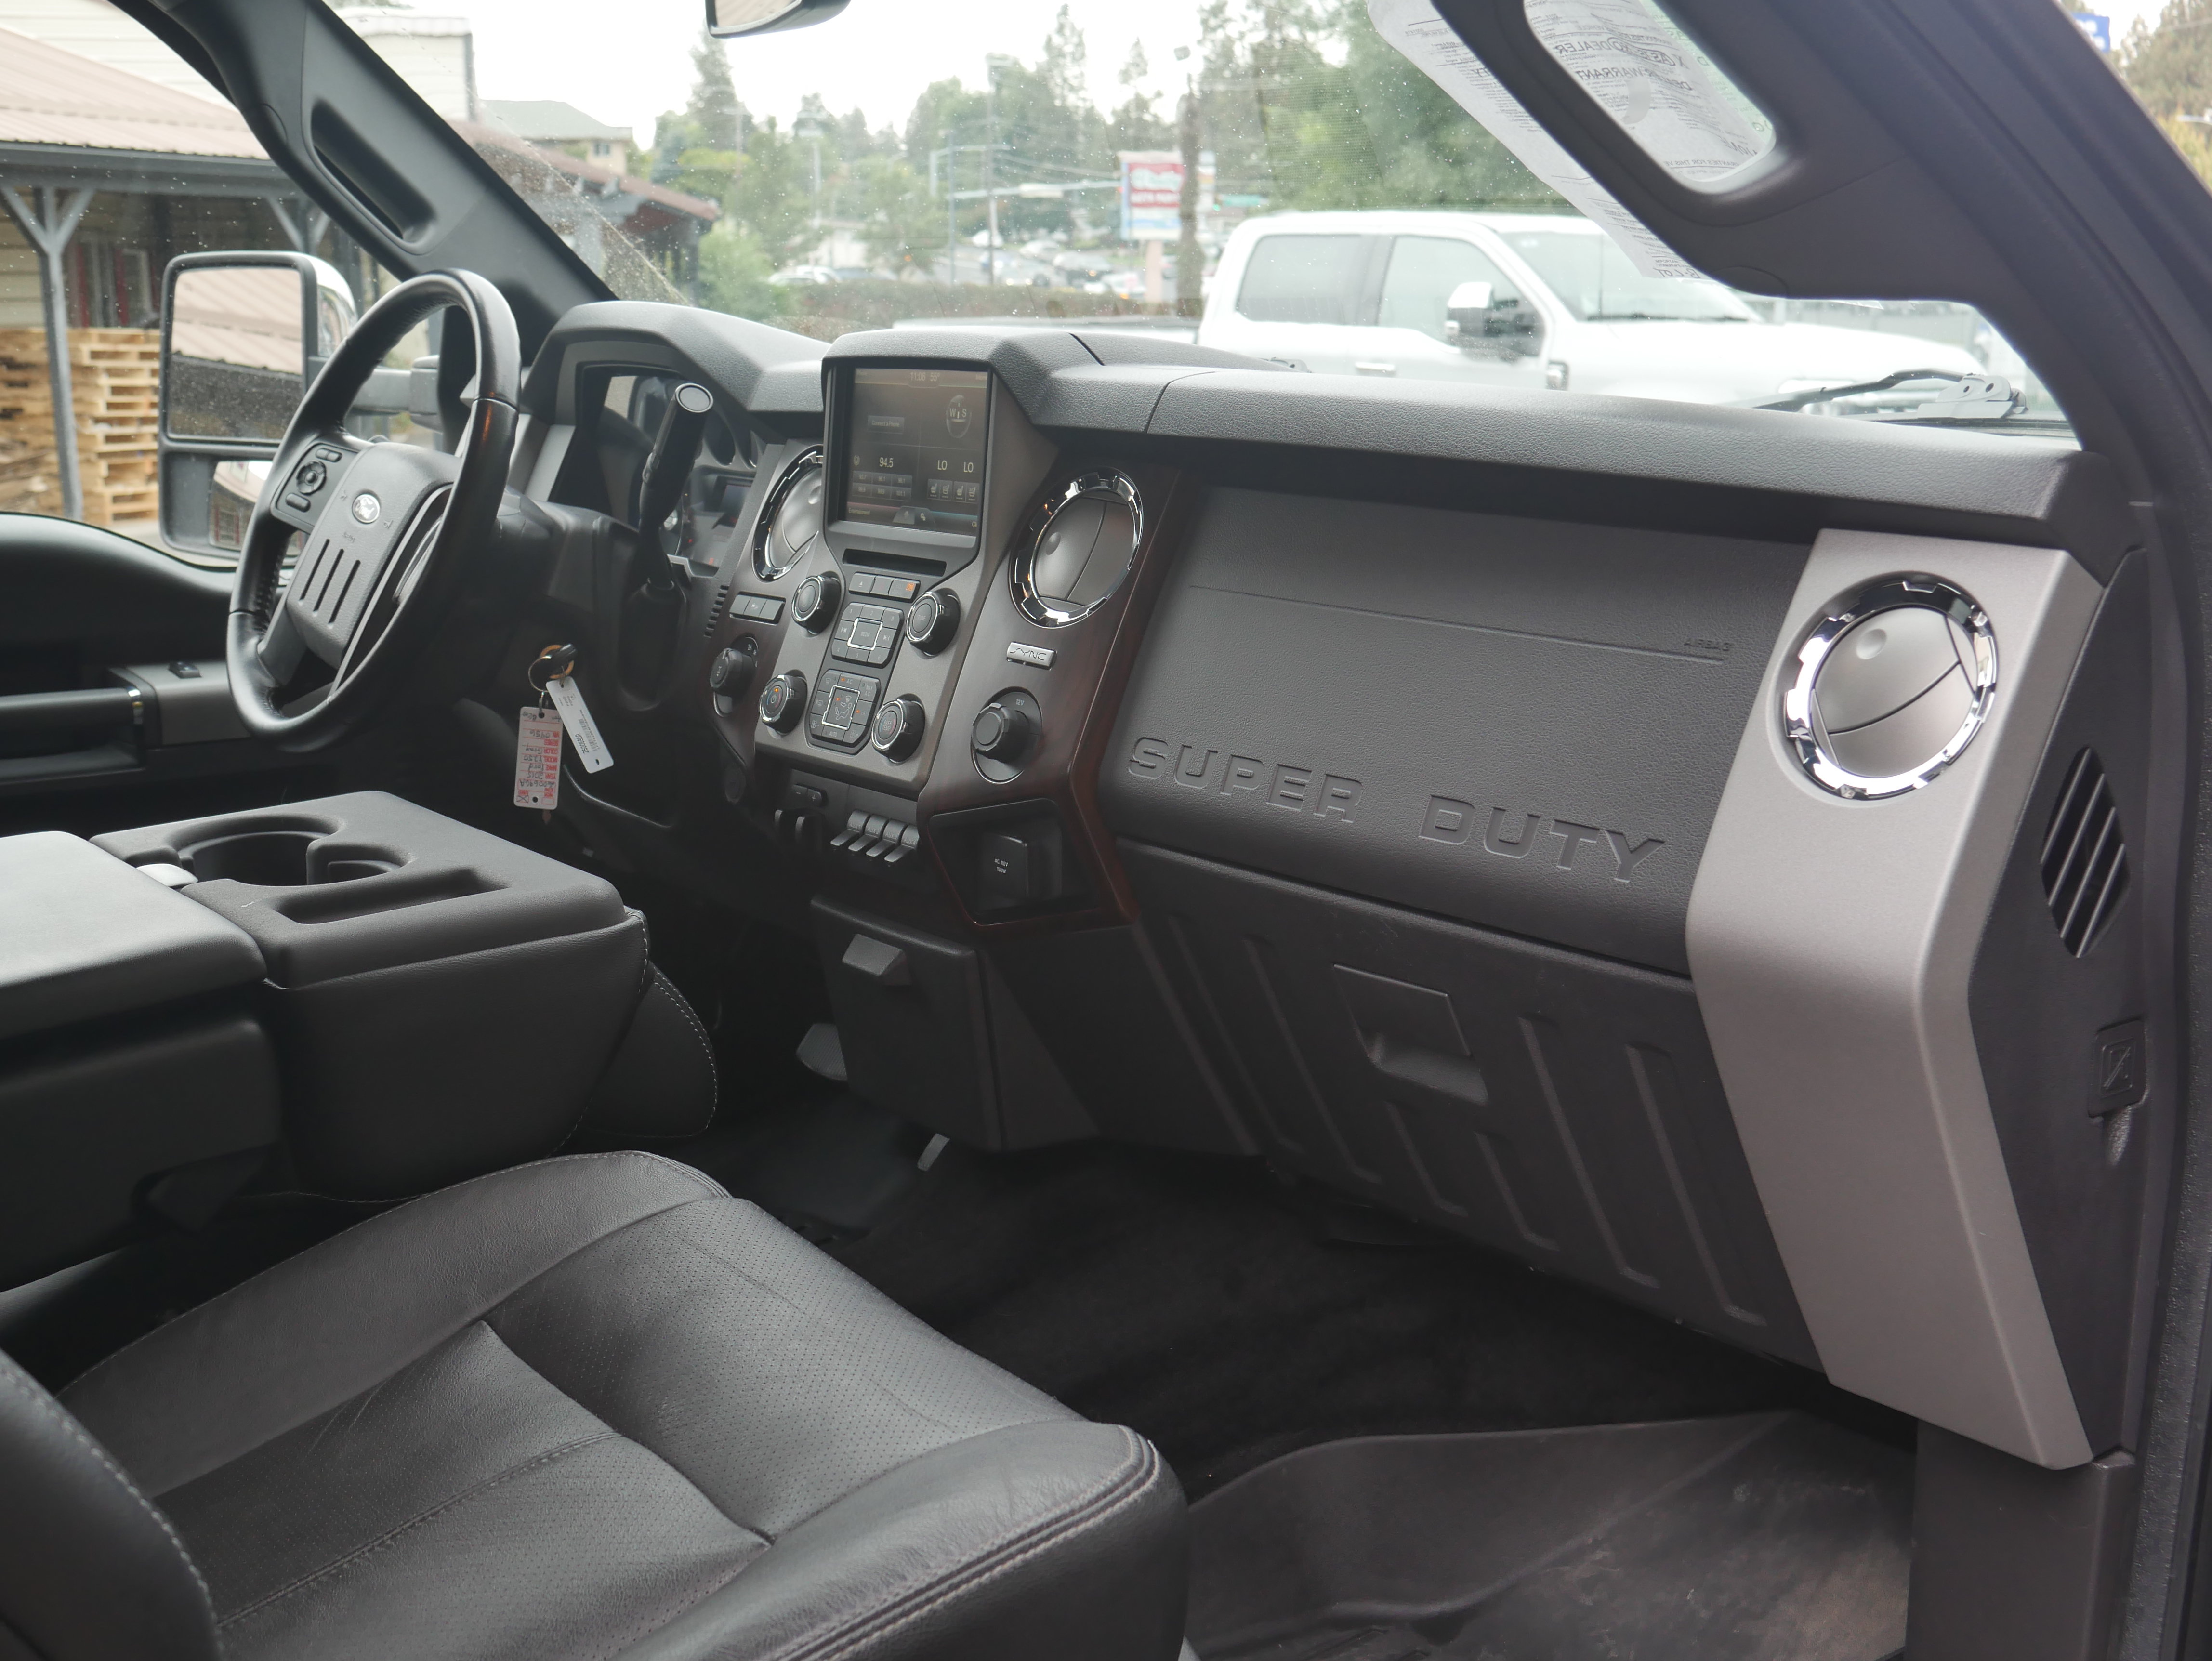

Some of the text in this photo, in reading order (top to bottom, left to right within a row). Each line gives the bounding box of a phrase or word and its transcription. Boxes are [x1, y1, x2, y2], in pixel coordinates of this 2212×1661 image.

[910, 372, 925, 381] 11:06
[949, 408, 967, 417] W S
[879, 457, 894, 467] 94.5
[937, 460, 974, 473] LO LO
[1010, 648, 1047, 661] SYNC
[1128, 736, 1665, 883] SUPER DUTY
